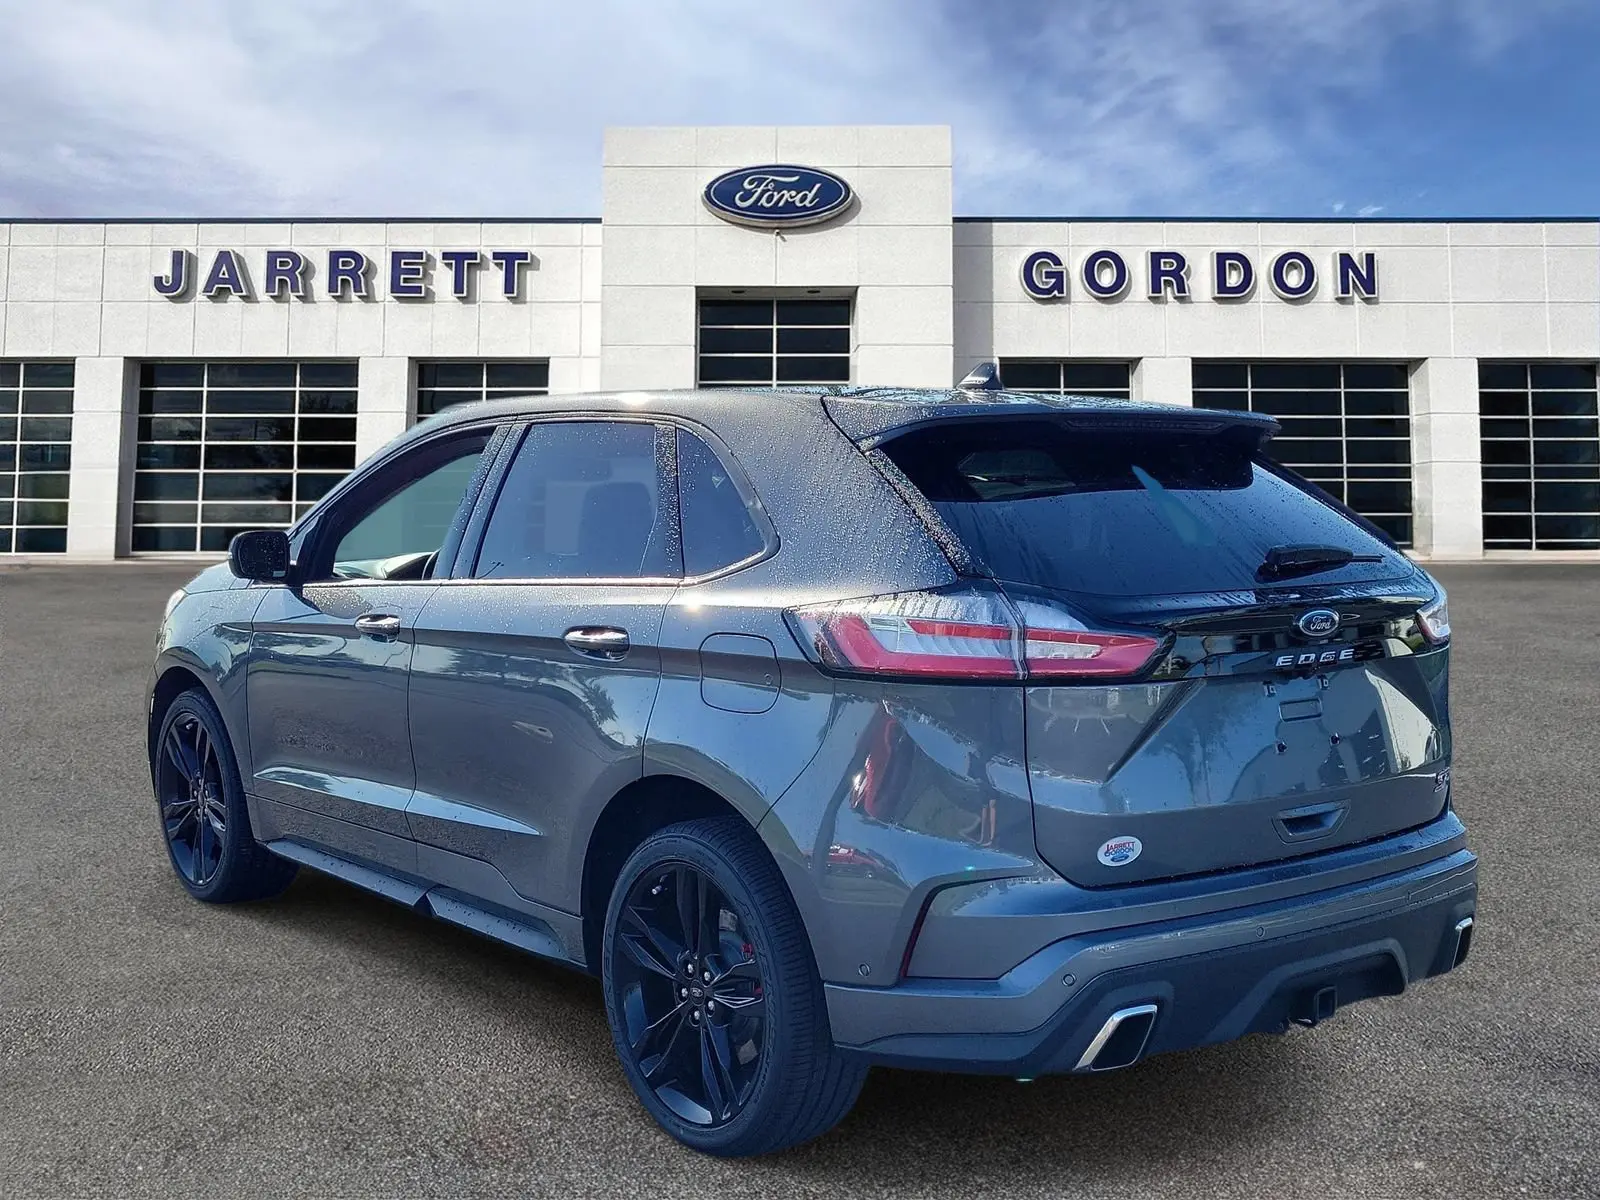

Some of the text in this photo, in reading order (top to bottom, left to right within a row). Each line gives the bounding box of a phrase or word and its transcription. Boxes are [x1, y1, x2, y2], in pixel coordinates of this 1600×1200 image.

[735, 174, 821, 208] Ford
[153, 249, 532, 297] JARRETT
[1022, 249, 1379, 299] GORDON
[1310, 615, 1332, 630] Ford
[1276, 649, 1355, 666] EDGE
[1104, 847, 1135, 857] GORDON
[1106, 841, 1136, 851] JARRETT
